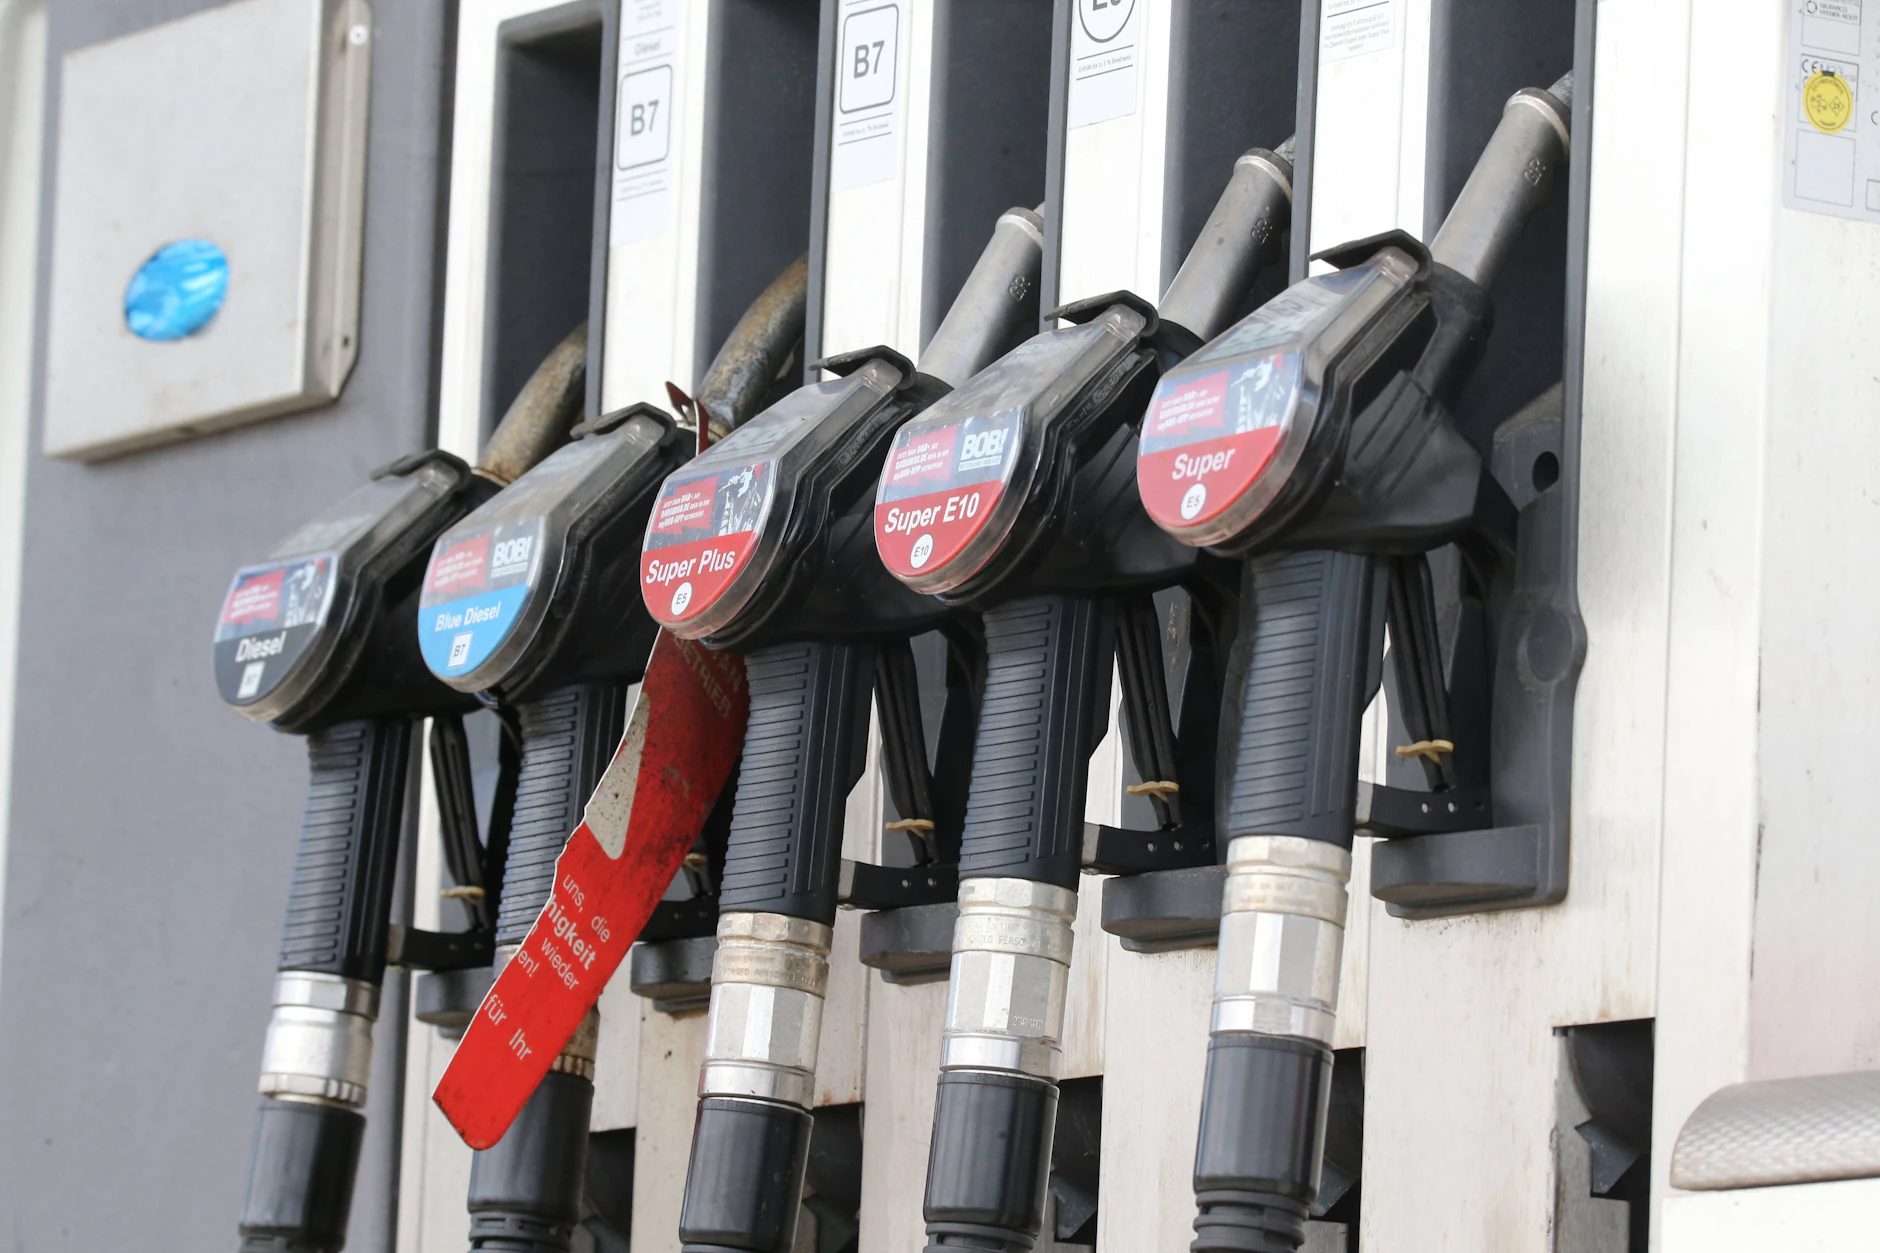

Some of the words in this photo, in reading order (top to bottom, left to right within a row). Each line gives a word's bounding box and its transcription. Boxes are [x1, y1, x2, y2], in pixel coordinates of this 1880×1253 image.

[854, 40, 885, 79] B7
[631, 99, 659, 136] B7
[960, 428, 1009, 461] BOB!
[1171, 447, 1236, 481] Super
[884, 505, 942, 536] Super
[943, 492, 980, 523] E10
[1186, 493, 1200, 509] E5
[645, 558, 697, 586] Super
[697, 548, 736, 575] Plus
[914, 545, 929, 558] E10
[675, 592, 688, 605] E5
[434, 614, 462, 632] Blue
[464, 601, 502, 626] Diesel
[235, 630, 287, 663] Diesel
[453, 643, 466, 657] B7
[562, 873, 585, 913] uns,
[590, 914, 612, 944] die
[544, 893, 596, 970] higkeit
[517, 950, 540, 978] en!
[541, 937, 580, 990] wieder
[483, 993, 507, 1027] für
[508, 1028, 533, 1061] Ihr
